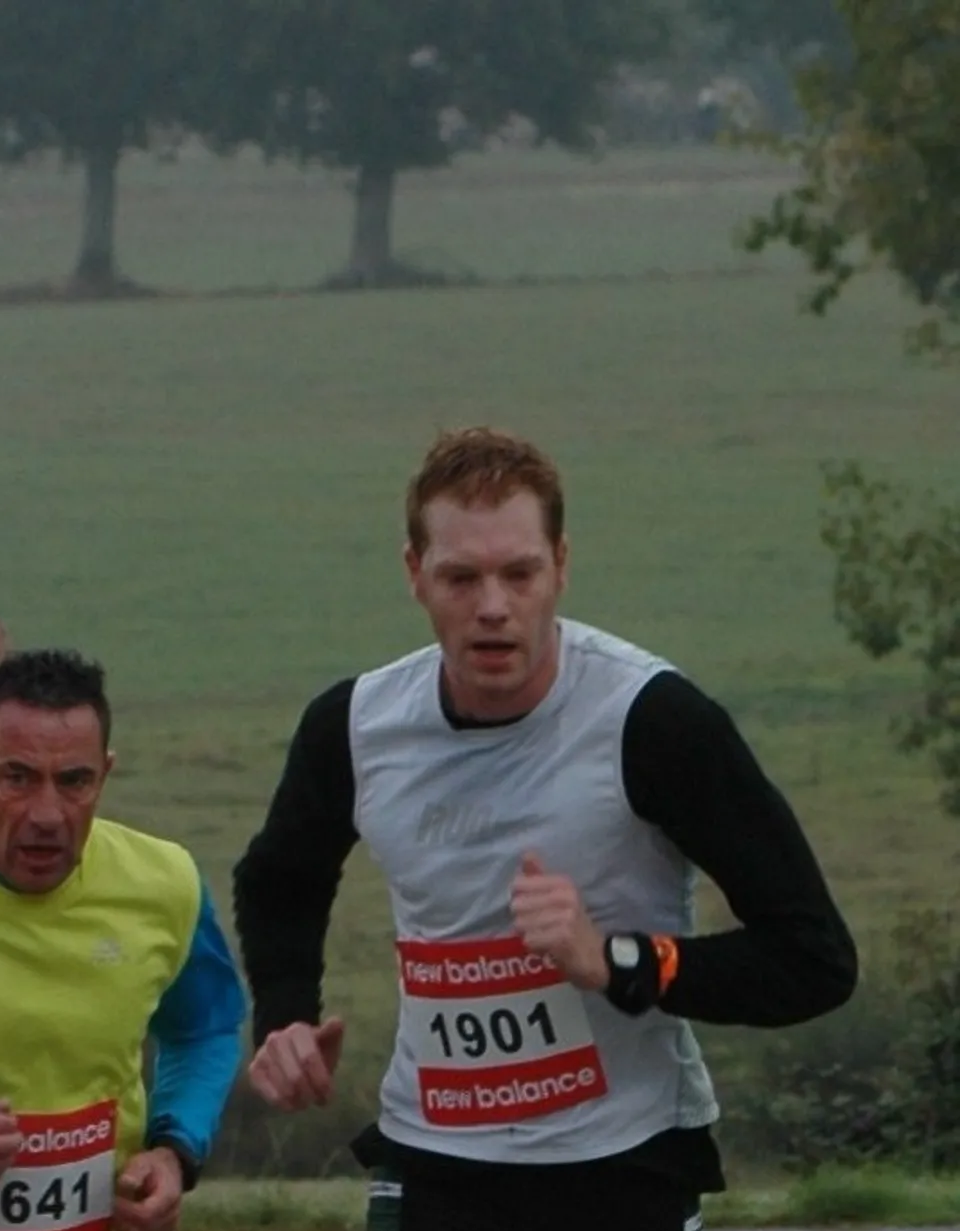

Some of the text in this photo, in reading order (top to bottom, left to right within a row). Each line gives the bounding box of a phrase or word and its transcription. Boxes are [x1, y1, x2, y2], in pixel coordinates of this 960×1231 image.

[405, 958, 442, 983] new
[429, 1001, 557, 1059] 1901
[426, 1067, 595, 1110] new balance
